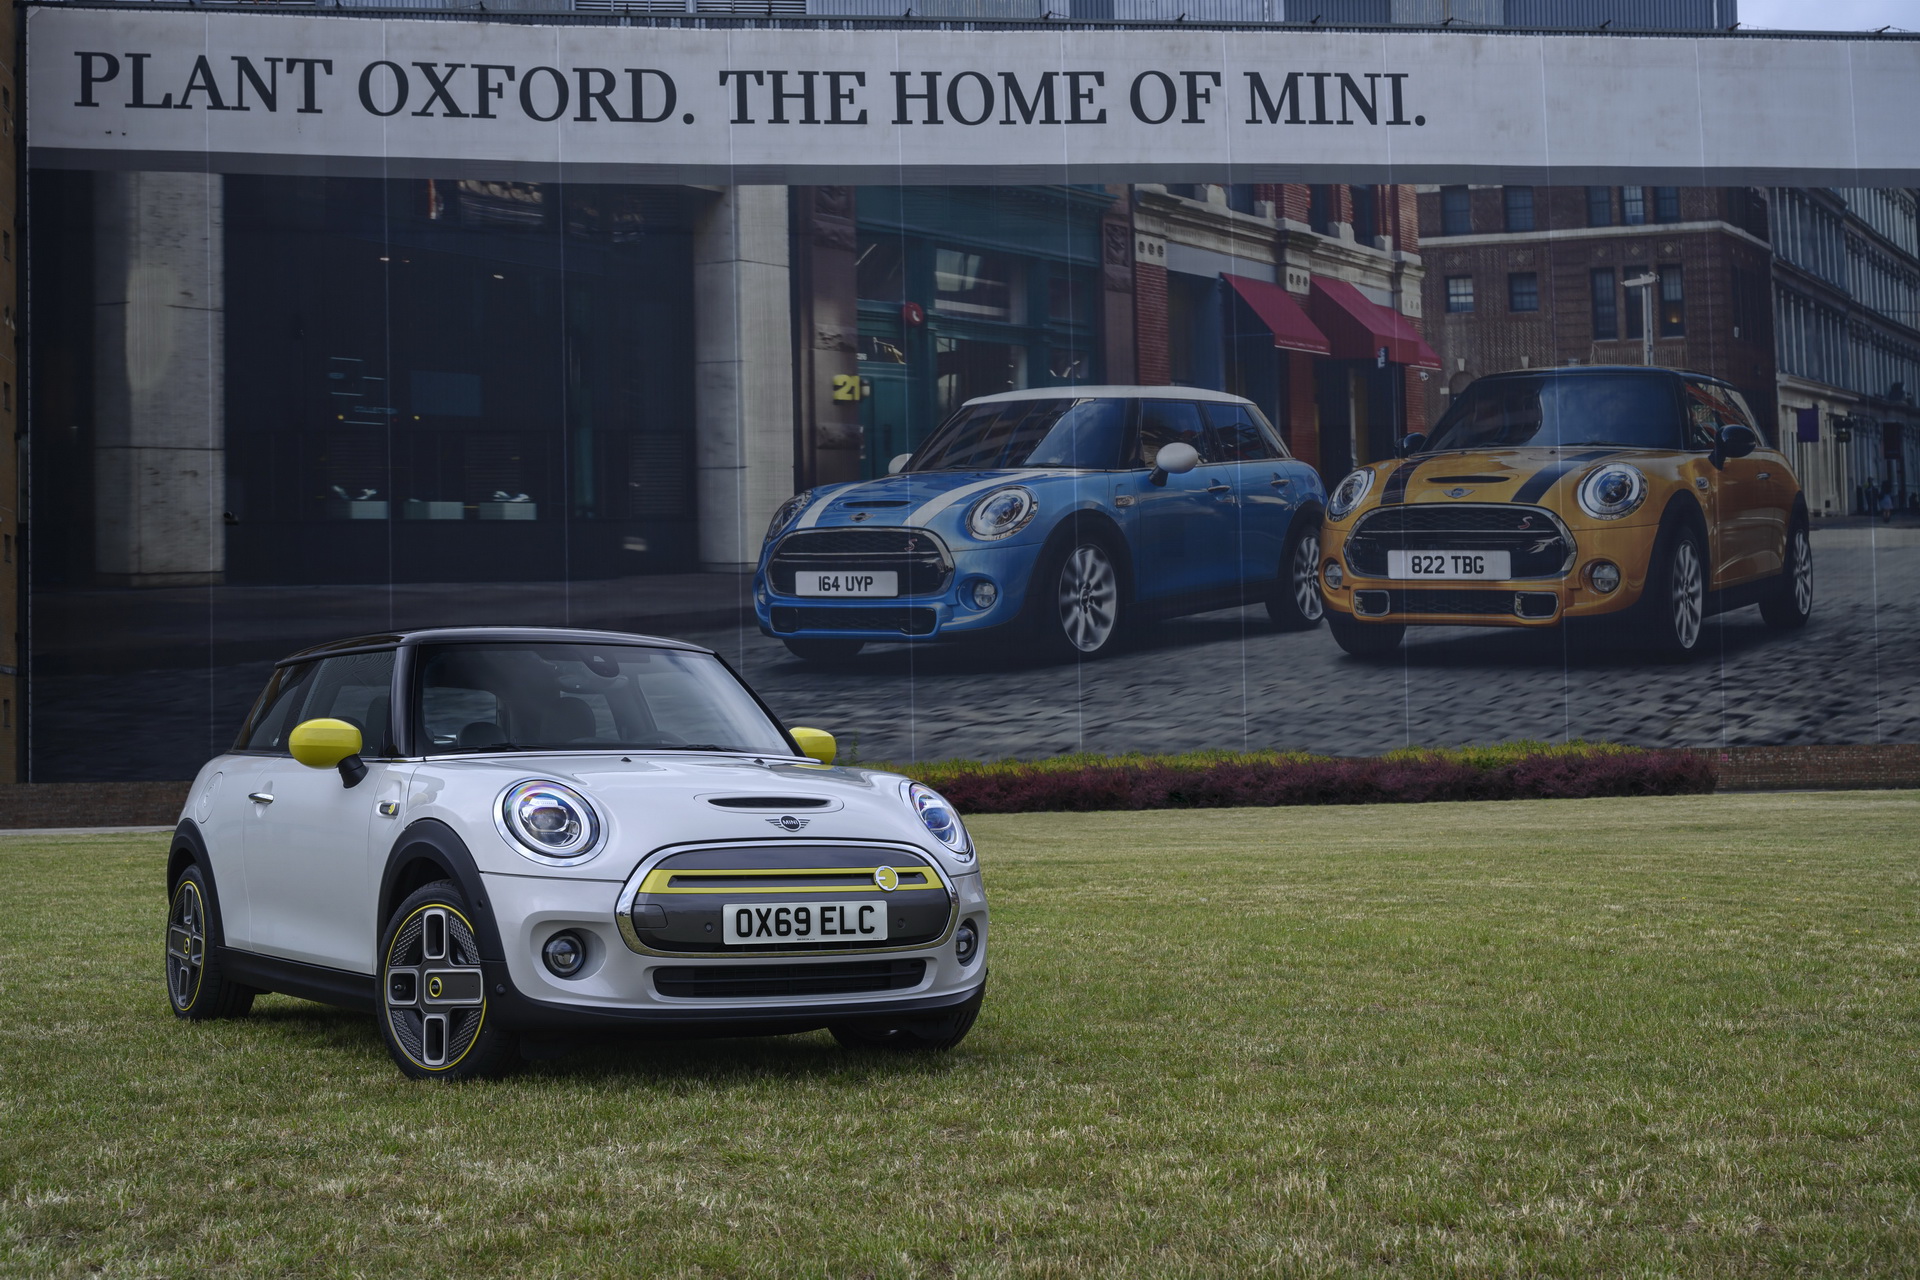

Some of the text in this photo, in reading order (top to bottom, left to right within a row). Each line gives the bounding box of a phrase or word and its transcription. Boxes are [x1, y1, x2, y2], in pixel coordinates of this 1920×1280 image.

[73, 50, 1426, 127] PLANT OXFORD. THE HOME OF MINI.
[833, 374, 860, 400] 21
[1411, 555, 1485, 575] 822 TBG
[818, 575, 874, 592] 164 UYP
[735, 905, 876, 938] OX69 ELC
